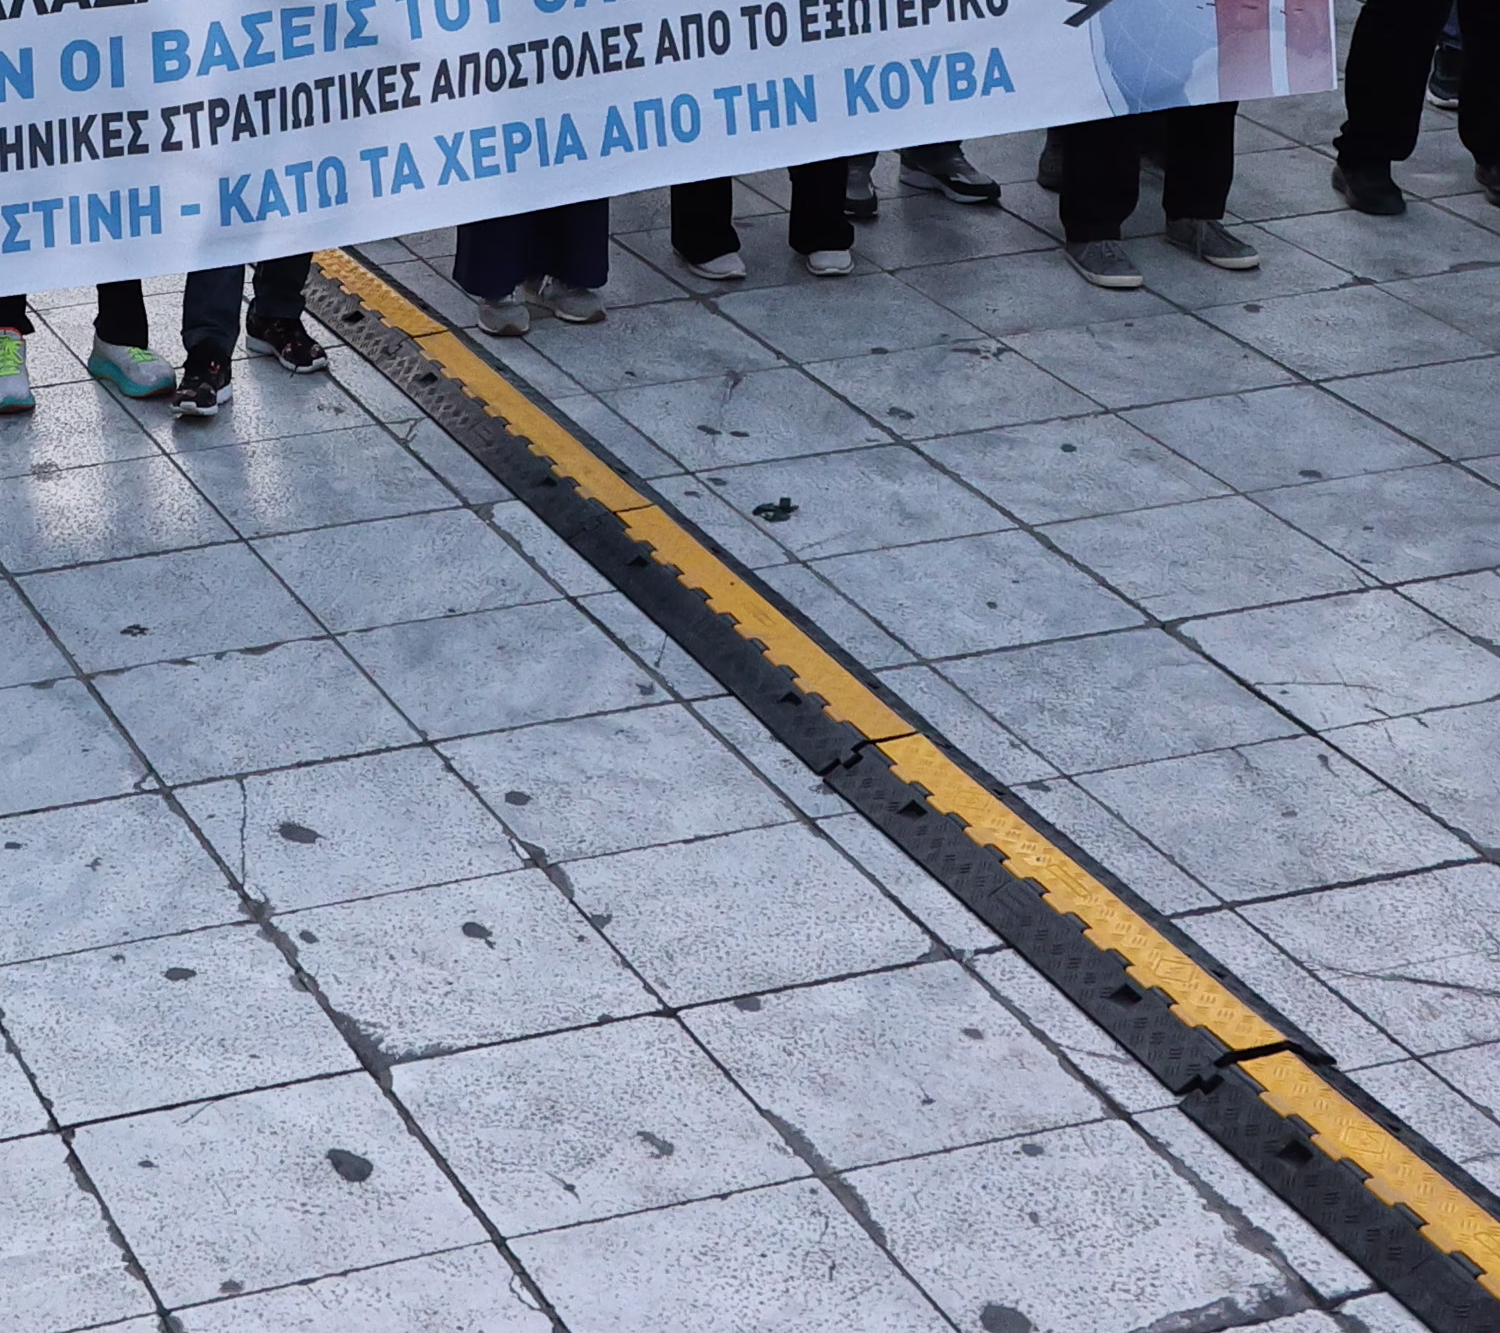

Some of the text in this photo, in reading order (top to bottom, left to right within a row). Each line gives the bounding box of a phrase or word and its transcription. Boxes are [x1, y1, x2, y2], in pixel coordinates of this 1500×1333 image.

[60, 35, 125, 92] ΟΙ
[160, 62, 422, 153] ΣΤΡΑΤΙΩΤΙΚΕΣ
[430, 22, 646, 104] ΑΠΟΣΤΟΛΕΣ
[654, 10, 730, 65] ΑΠΟ
[740, 1, 788, 51] ΤΟ
[180, 203, 202, 217] -
[218, 156, 349, 227] ΚΑΤΩ
[359, 142, 425, 198] ΤΑ
[434, 112, 588, 186] ΧΕΡΙΑ
[600, 93, 701, 158] ΑΠΟ
[713, 73, 818, 137] ΤΗΝ
[843, 47, 1016, 118] ΚΟΥΒΑ
